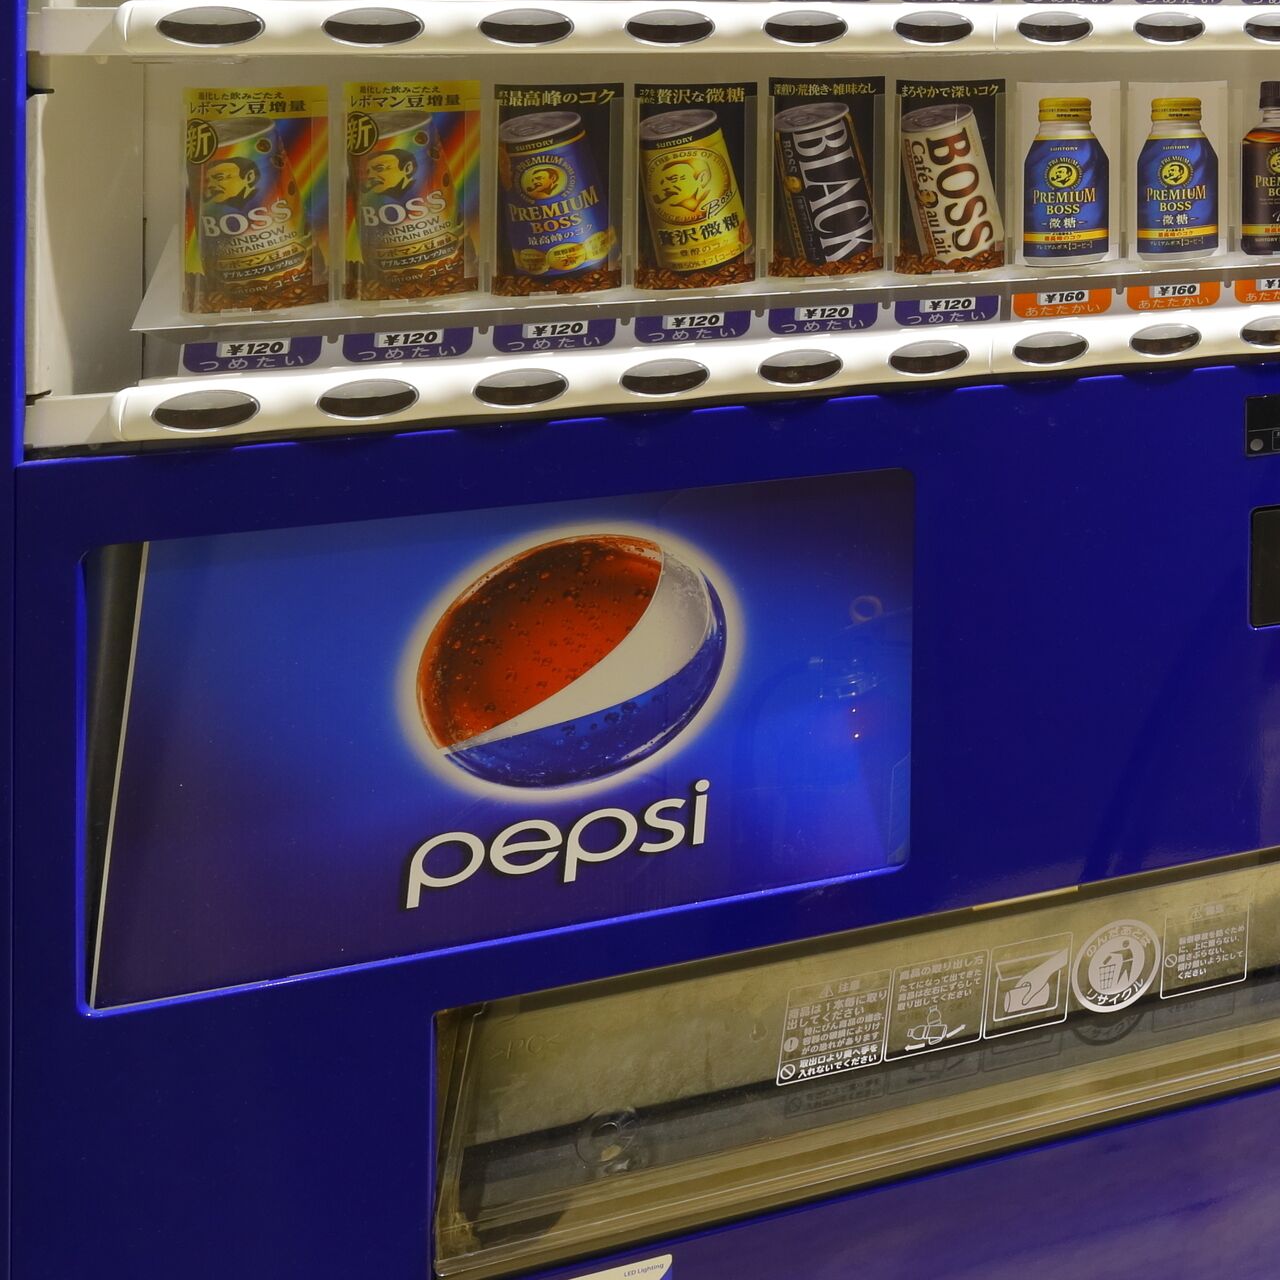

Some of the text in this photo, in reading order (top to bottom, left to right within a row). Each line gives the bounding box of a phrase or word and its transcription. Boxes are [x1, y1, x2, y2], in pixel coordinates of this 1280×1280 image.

[657, 86, 745, 106] 贅沢な微糖
[792, 120, 874, 262] BLACK
[912, 141, 951, 255] Café au Lait
[926, 127, 993, 252] BOSS
[1033, 188, 1096, 203] PREMIUM
[1146, 185, 1206, 201] PREMIUM
[362, 191, 447, 226] BOSS
[201, 199, 292, 237] BOSS
[1026, 303, 1101, 317] あたたかい
[1138, 297, 1210, 309] あたたかい
[648, 327, 736, 340] つめたい
[781, 320, 864, 332] つめたい
[384, 331, 437, 345] ¥120
[507, 335, 600, 350] つめたい
[227, 342, 284, 355] ¥120
[359, 346, 456, 360] つめたい
[200, 355, 303, 370] つめたい
[406, 779, 711, 909] pepsi
[898, 955, 984, 979] 商品の取り出し方
[897, 988, 971, 1011] 取り出してください
[1086, 978, 1144, 1005] リサイクル
[787, 1007, 865, 1030] 出してください
[798, 1055, 877, 1079] 入れないでください
[638, 1264, 664, 1274] Lighting
